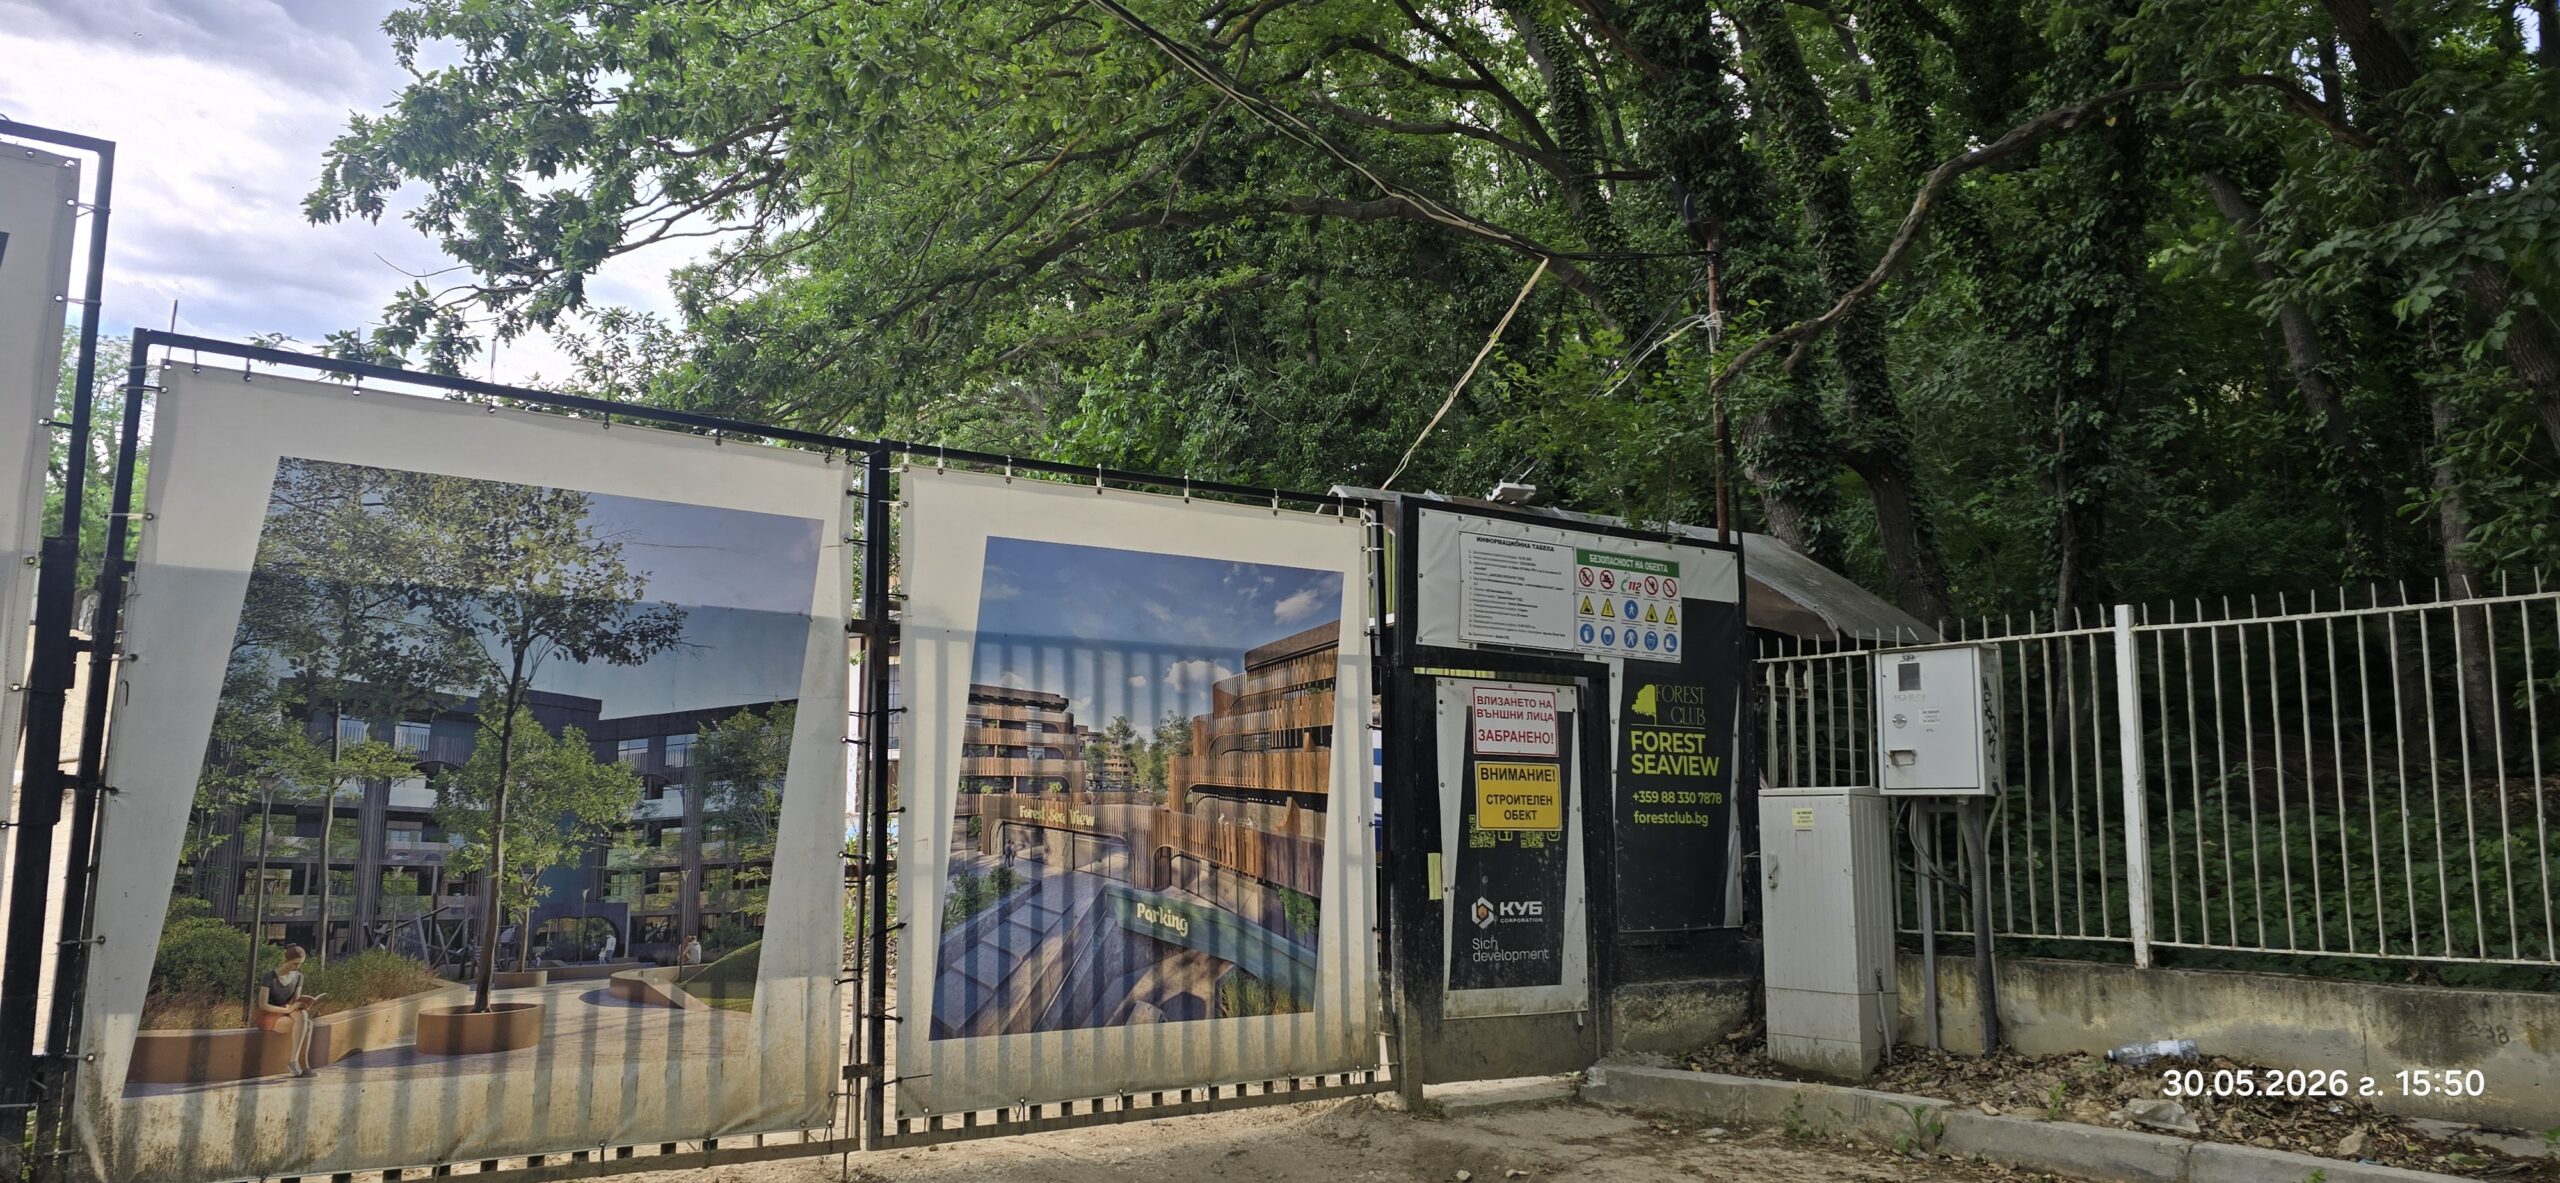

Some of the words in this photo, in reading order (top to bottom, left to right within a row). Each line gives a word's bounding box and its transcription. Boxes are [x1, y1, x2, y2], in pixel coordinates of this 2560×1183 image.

[1476, 536, 1531, 549] ИНФОРМАЦИОННА
[1589, 554, 1634, 568] БЕЗОПАСНОСТ
[1634, 560, 1644, 569] НА
[1645, 561, 1668, 573] ОБЕКТА
[1628, 581, 1642, 591] 112
[1656, 684, 1705, 705] FOREST
[1477, 696, 1537, 708] ВЛИЗАНЕТО
[1539, 700, 1552, 709] НА
[1477, 709, 1523, 720] ВЪНШНИ
[1526, 711, 1554, 723] ЛИЦА
[1671, 706, 1706, 726] CLUB
[1478, 729, 1554, 745] ЗАБРАНЕНО!
[1631, 730, 1706, 754] FOREST
[1631, 753, 1720, 776] SEAVIEW
[1480, 767, 1556, 782] ВНИМАНИЕ!
[1486, 794, 1553, 806] СТРОИТЕЛЕН
[1633, 791, 1659, 804] +359
[1661, 791, 1675, 804] 88
[1677, 791, 1696, 804] 330
[1698, 792, 1722, 804] 7878
[1019, 805, 1045, 820] Forest
[1048, 808, 1066, 824] Sea
[1070, 809, 1095, 826] View
[1504, 809, 1537, 821] ОБЕКТ
[1634, 810, 1709, 827] forestclub.bg
[1499, 901, 1542, 916] КУБ
[1137, 903, 1188, 937] Parking
[1472, 936, 1498, 950] Sich
[1472, 949, 1549, 963] development
